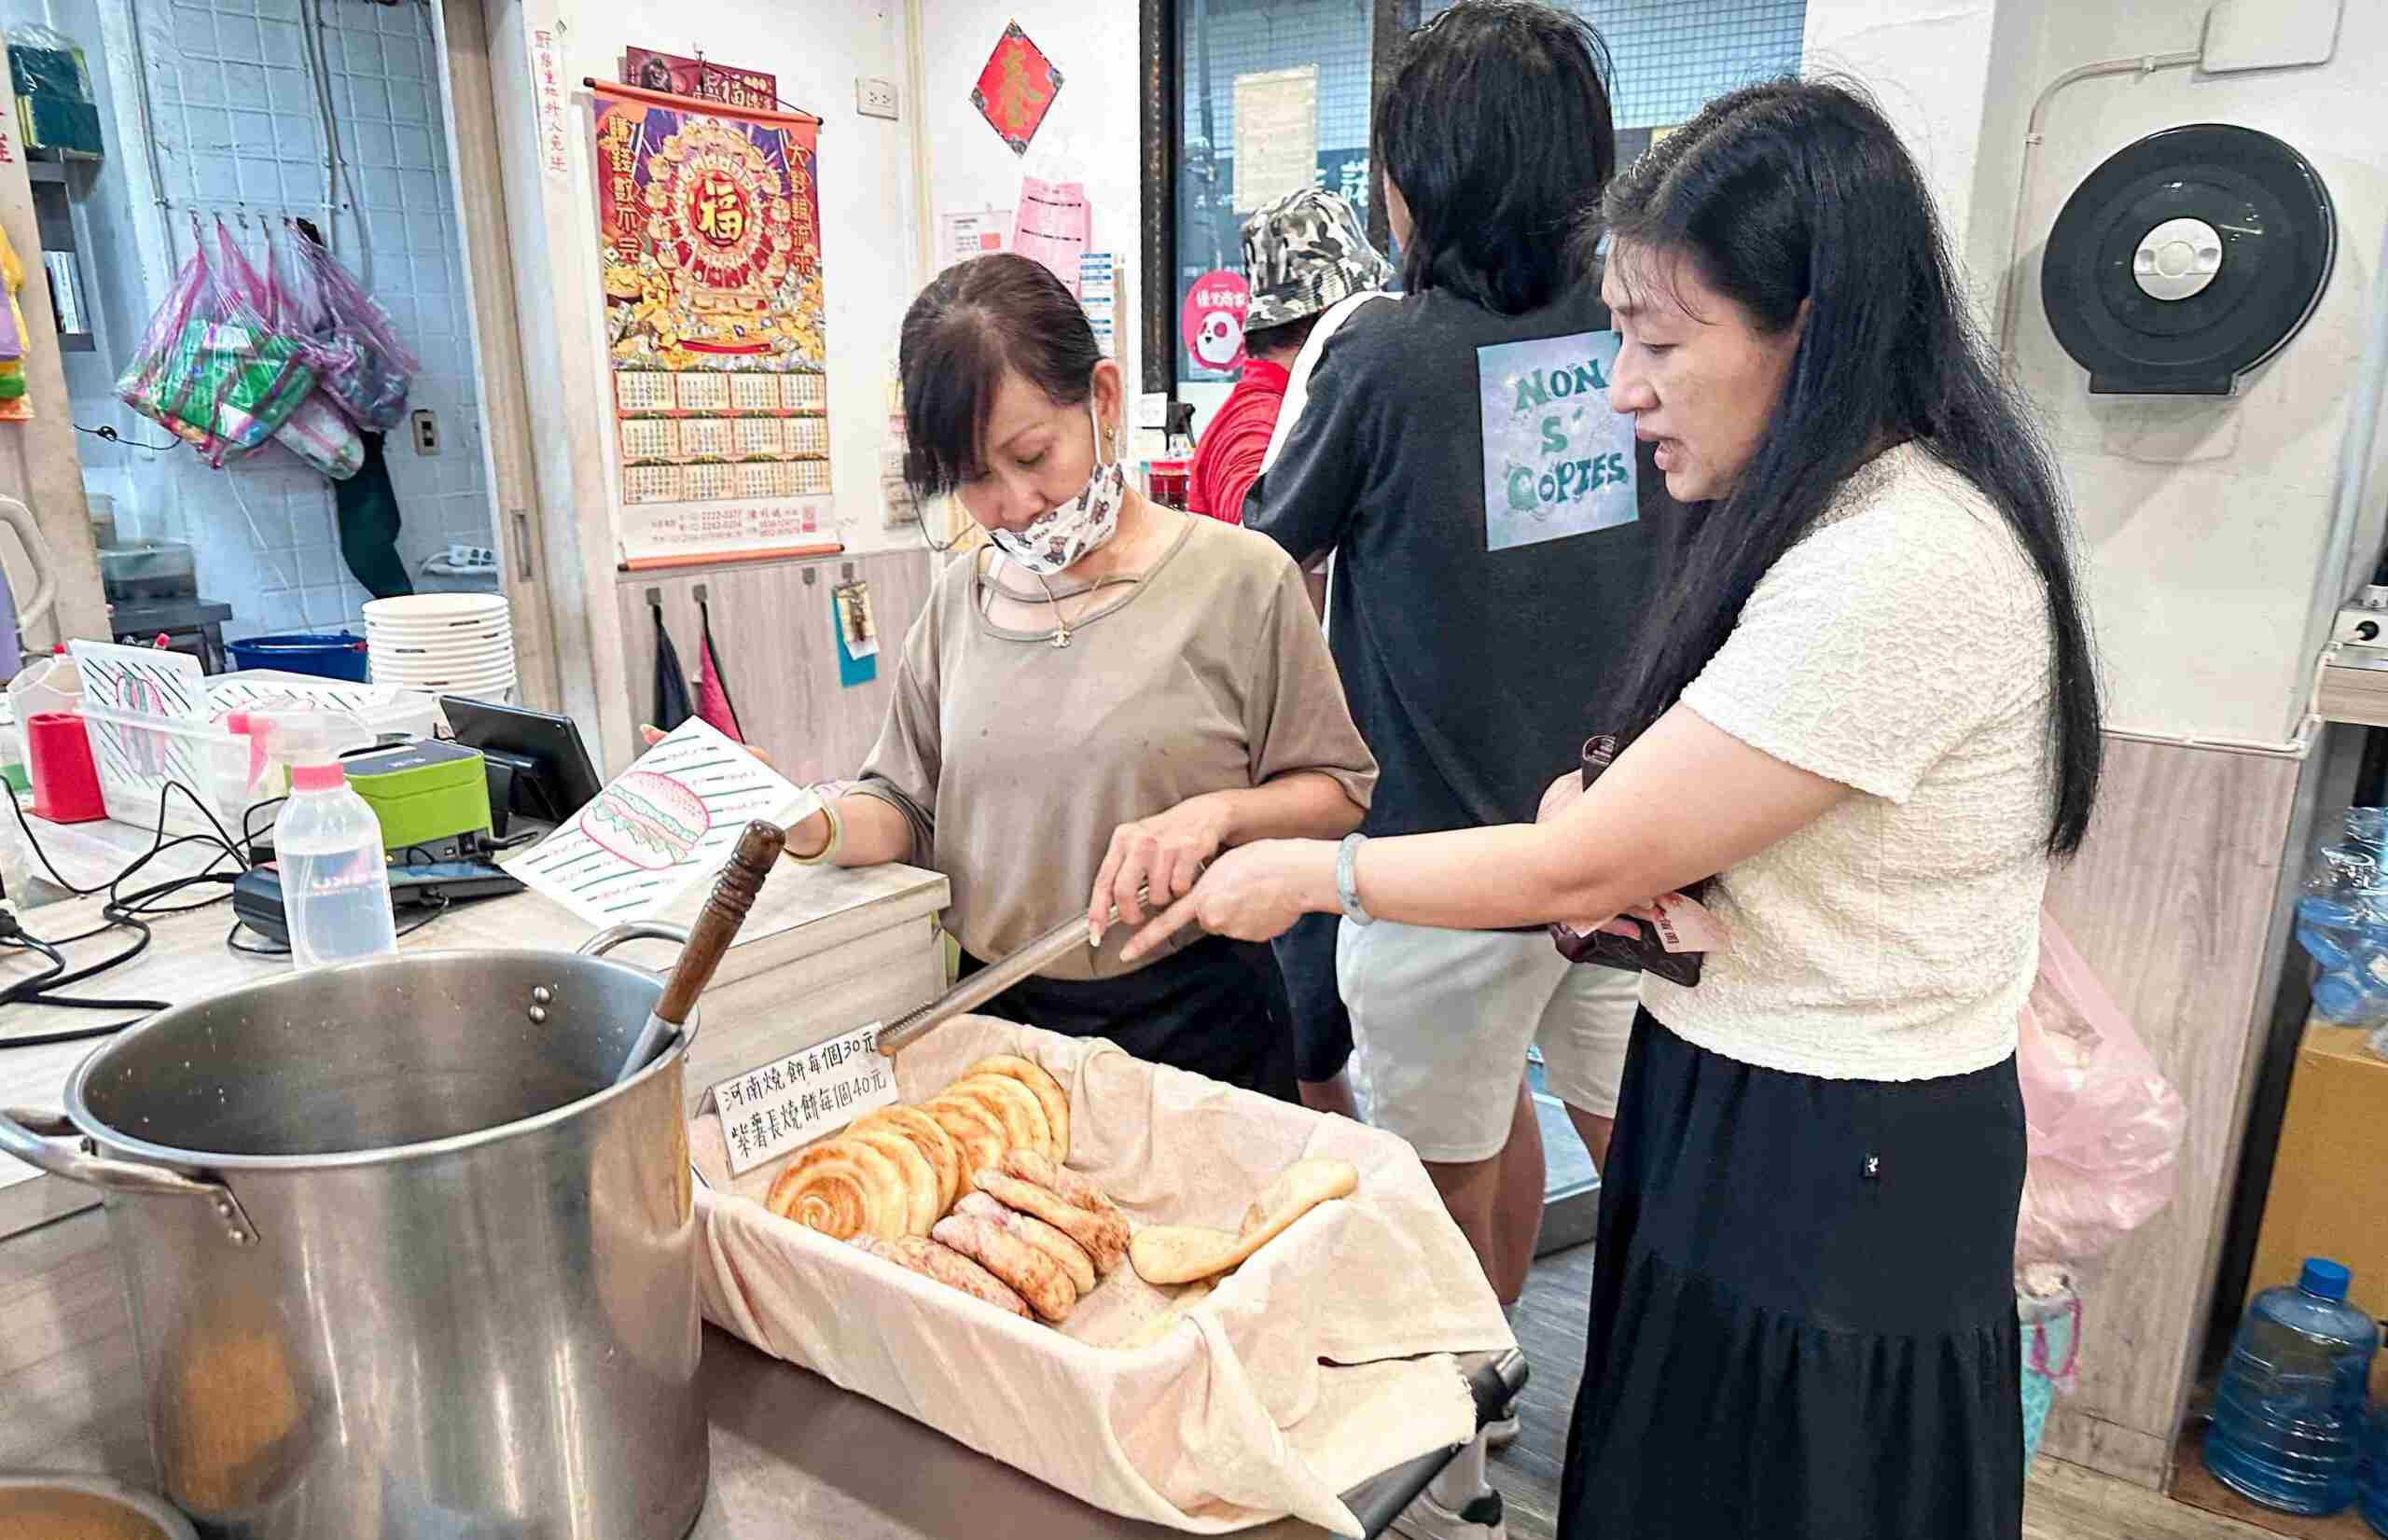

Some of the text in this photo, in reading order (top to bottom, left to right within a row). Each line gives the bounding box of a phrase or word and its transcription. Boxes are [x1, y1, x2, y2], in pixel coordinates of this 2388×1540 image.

[698, 177, 744, 243] 福
[1514, 358, 1610, 412] NON
[1506, 453, 1629, 510] COPIES
